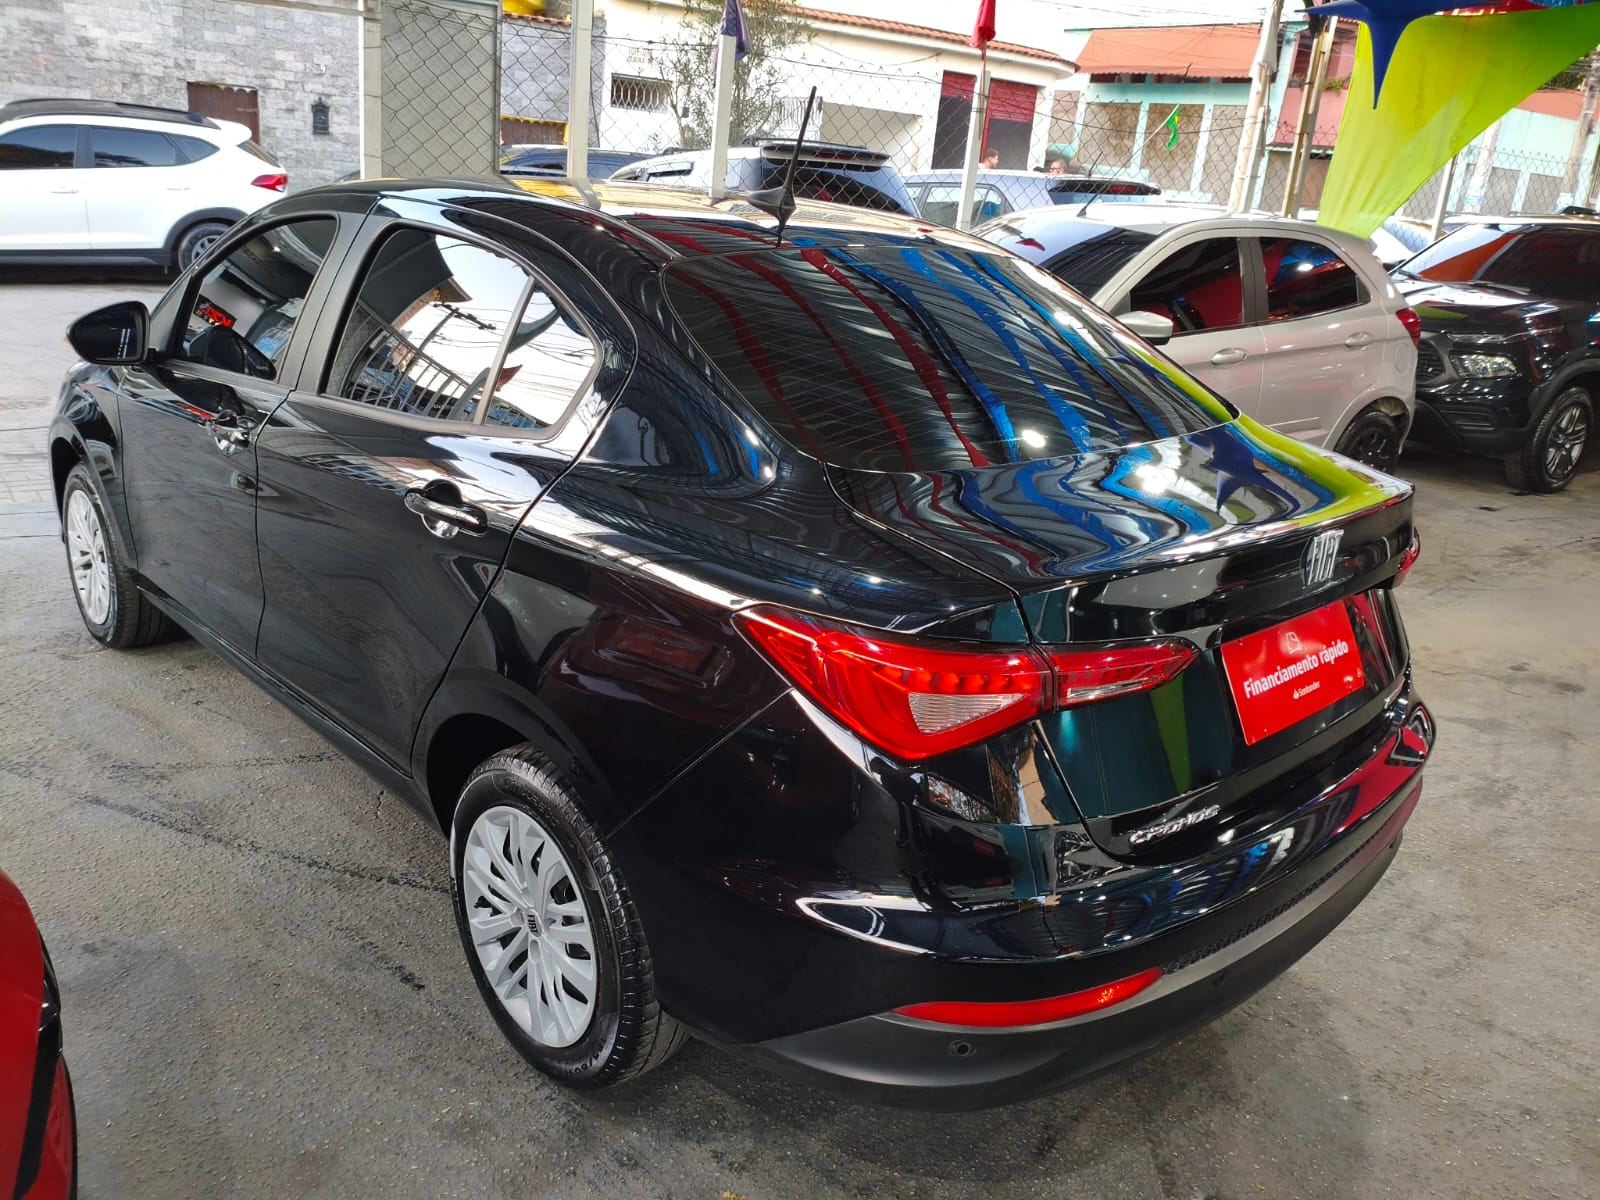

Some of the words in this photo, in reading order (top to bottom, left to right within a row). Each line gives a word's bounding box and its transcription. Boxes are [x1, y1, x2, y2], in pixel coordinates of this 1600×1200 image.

[1306, 529, 1345, 586] FIAT
[1242, 653, 1319, 699] Financiamento
[1319, 638, 1349, 665] rápido
